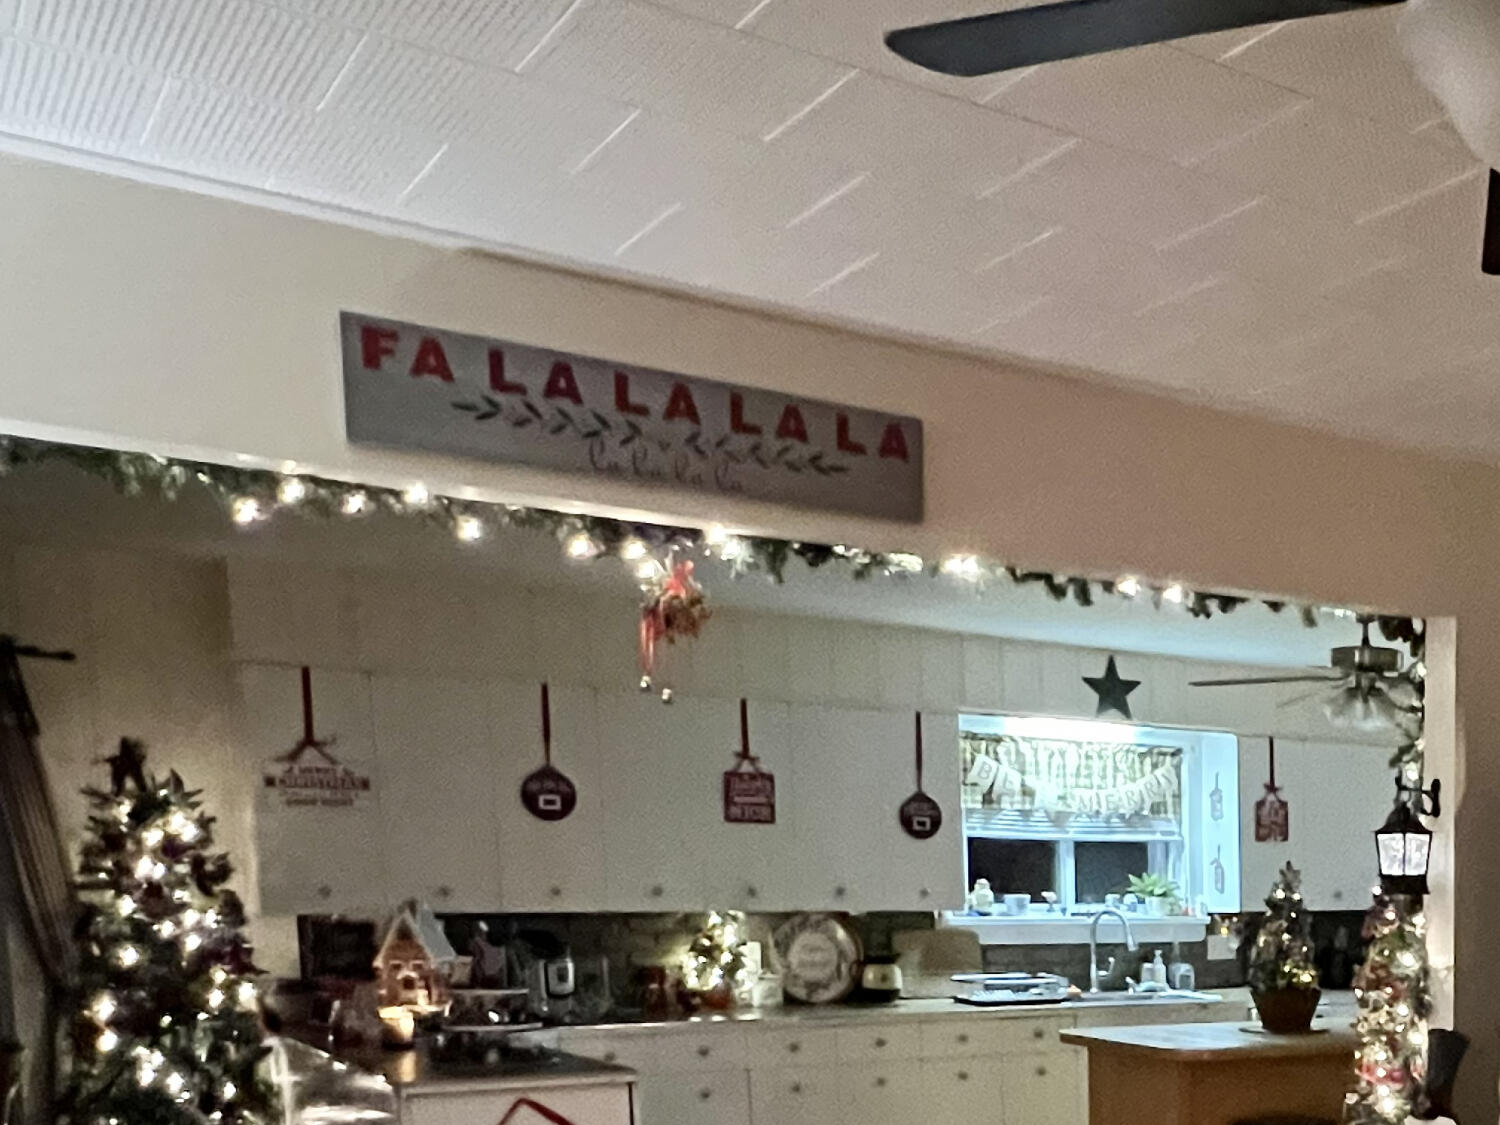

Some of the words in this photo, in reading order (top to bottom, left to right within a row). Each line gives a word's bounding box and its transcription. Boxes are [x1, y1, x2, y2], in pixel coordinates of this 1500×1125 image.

[360, 325, 455, 383] FA
[487, 347, 584, 406] LA
[614, 370, 701, 426] LA
[729, 391, 809, 444] LA
[836, 412, 910, 462] LA
[1078, 773, 1175, 811] MERRY
